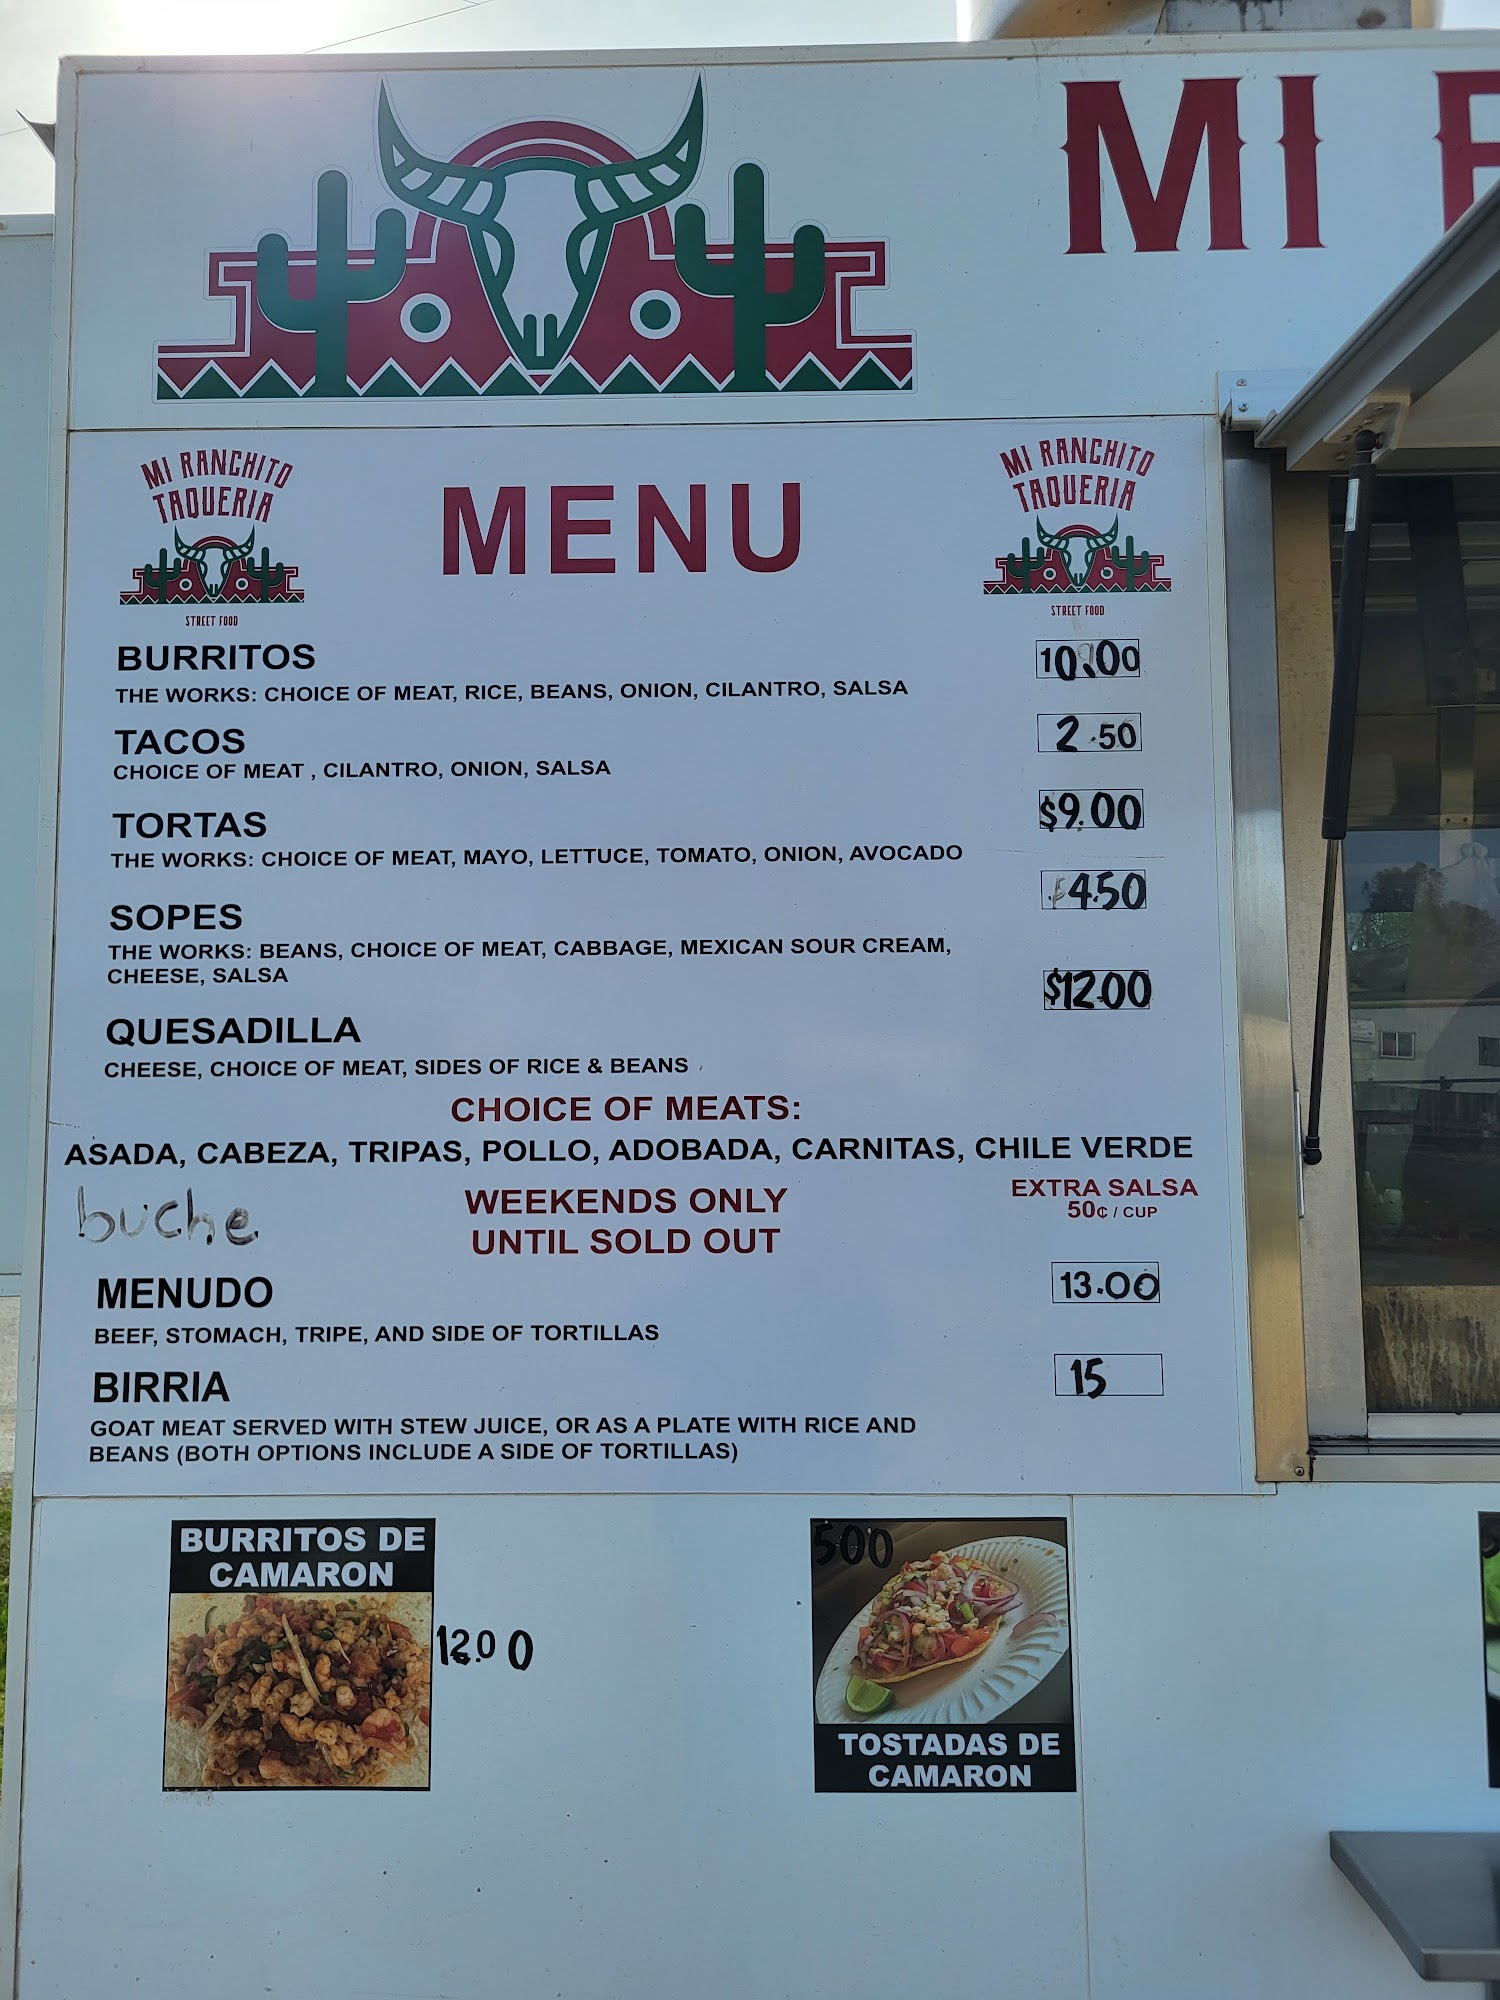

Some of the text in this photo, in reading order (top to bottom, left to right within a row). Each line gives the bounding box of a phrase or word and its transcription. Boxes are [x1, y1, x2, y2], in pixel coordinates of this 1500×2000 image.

[1060, 75, 1327, 255] MI
[140, 448, 294, 490] MI RANCHITO
[999, 437, 1155, 480] MI RANCHITO
[151, 486, 275, 524] TAQUERIA
[1012, 474, 1137, 513] TAQUERIA
[442, 483, 802, 576] MENU
[184, 614, 239, 627] STREET FOOD
[1050, 604, 1105, 617] STREET FOOD
[117, 643, 316, 672] BURRITOS
[114, 679, 909, 704] THE WORKS: CHOICE OF MEAT, RICE, BEANS, ONION, CILANTRO, SALSA
[114, 728, 246, 756] TACOS
[113, 764, 199, 781] CHOICE
[206, 763, 237, 780] OF
[243, 763, 305, 779] MEAT
[323, 761, 443, 780] CILANTRO,
[450, 760, 529, 779] ONION,
[535, 759, 612, 776] SALSA
[111, 811, 267, 839] TORTAS
[1040, 791, 1142, 833] $9.00
[110, 844, 963, 869] THE WORKS: CHOICE OF MEAT, MAYO, LETTUCE, TOMATO, ONION, AVOCADO
[109, 903, 243, 932] SOPES
[107, 937, 951, 962] THE WORKS: BEANS, CHOICE OF MEAT, CABBAGE, MEXICAN SOUR CREAM,
[107, 967, 289, 987] CHEESE, SALSA
[106, 1016, 362, 1048] QUESADILLA
[104, 1061, 203, 1081] CHEESE,
[210, 1060, 298, 1078] CHOICE
[304, 1060, 336, 1077] OF
[342, 1059, 407, 1079] MEAT,
[414, 1058, 482, 1076] SIDES
[488, 1058, 520, 1075] OF
[527, 1058, 581, 1075] RICE
[610, 1057, 689, 1074] BEANS
[451, 1094, 800, 1123] CHOICE OF MEATS:
[63, 1136, 1193, 1169] ASADA, CABEZA, TRIPAS, POLLO, ADOBADA, CARNITAS, CHILE VERDE
[464, 1187, 789, 1215] WEEKENDS ONLY
[1011, 1178, 1199, 1197] EXTRA SALSA
[76, 1185, 260, 1246] buche
[1122, 1206, 1158, 1218] CUP
[472, 1227, 781, 1255] UNTIL SOLD OUT
[97, 1276, 274, 1310] MENUDO
[1060, 1270, 1160, 1301] 13.00
[94, 1324, 660, 1348] BEEF, STOMACH, TRIPE, AND SIDE OF TORTILLAS
[93, 1370, 231, 1404] BIRRIA
[1069, 1357, 1107, 1399] 15
[90, 1416, 916, 1438] GOAT MEAT SERVED WITH STEW JUICE, OR AS A PLATE WITH RICE AND
[89, 1442, 738, 1467] BEANS (BOTH OPTIONS INCLUDE A SIDE OF TORTILLAS)
[181, 1527, 425, 1552] BURRITOS DE
[210, 1562, 393, 1587] CAMARON
[839, 1733, 1059, 1755] TOSTADAS DE
[869, 1765, 1031, 1787] CAMARON
